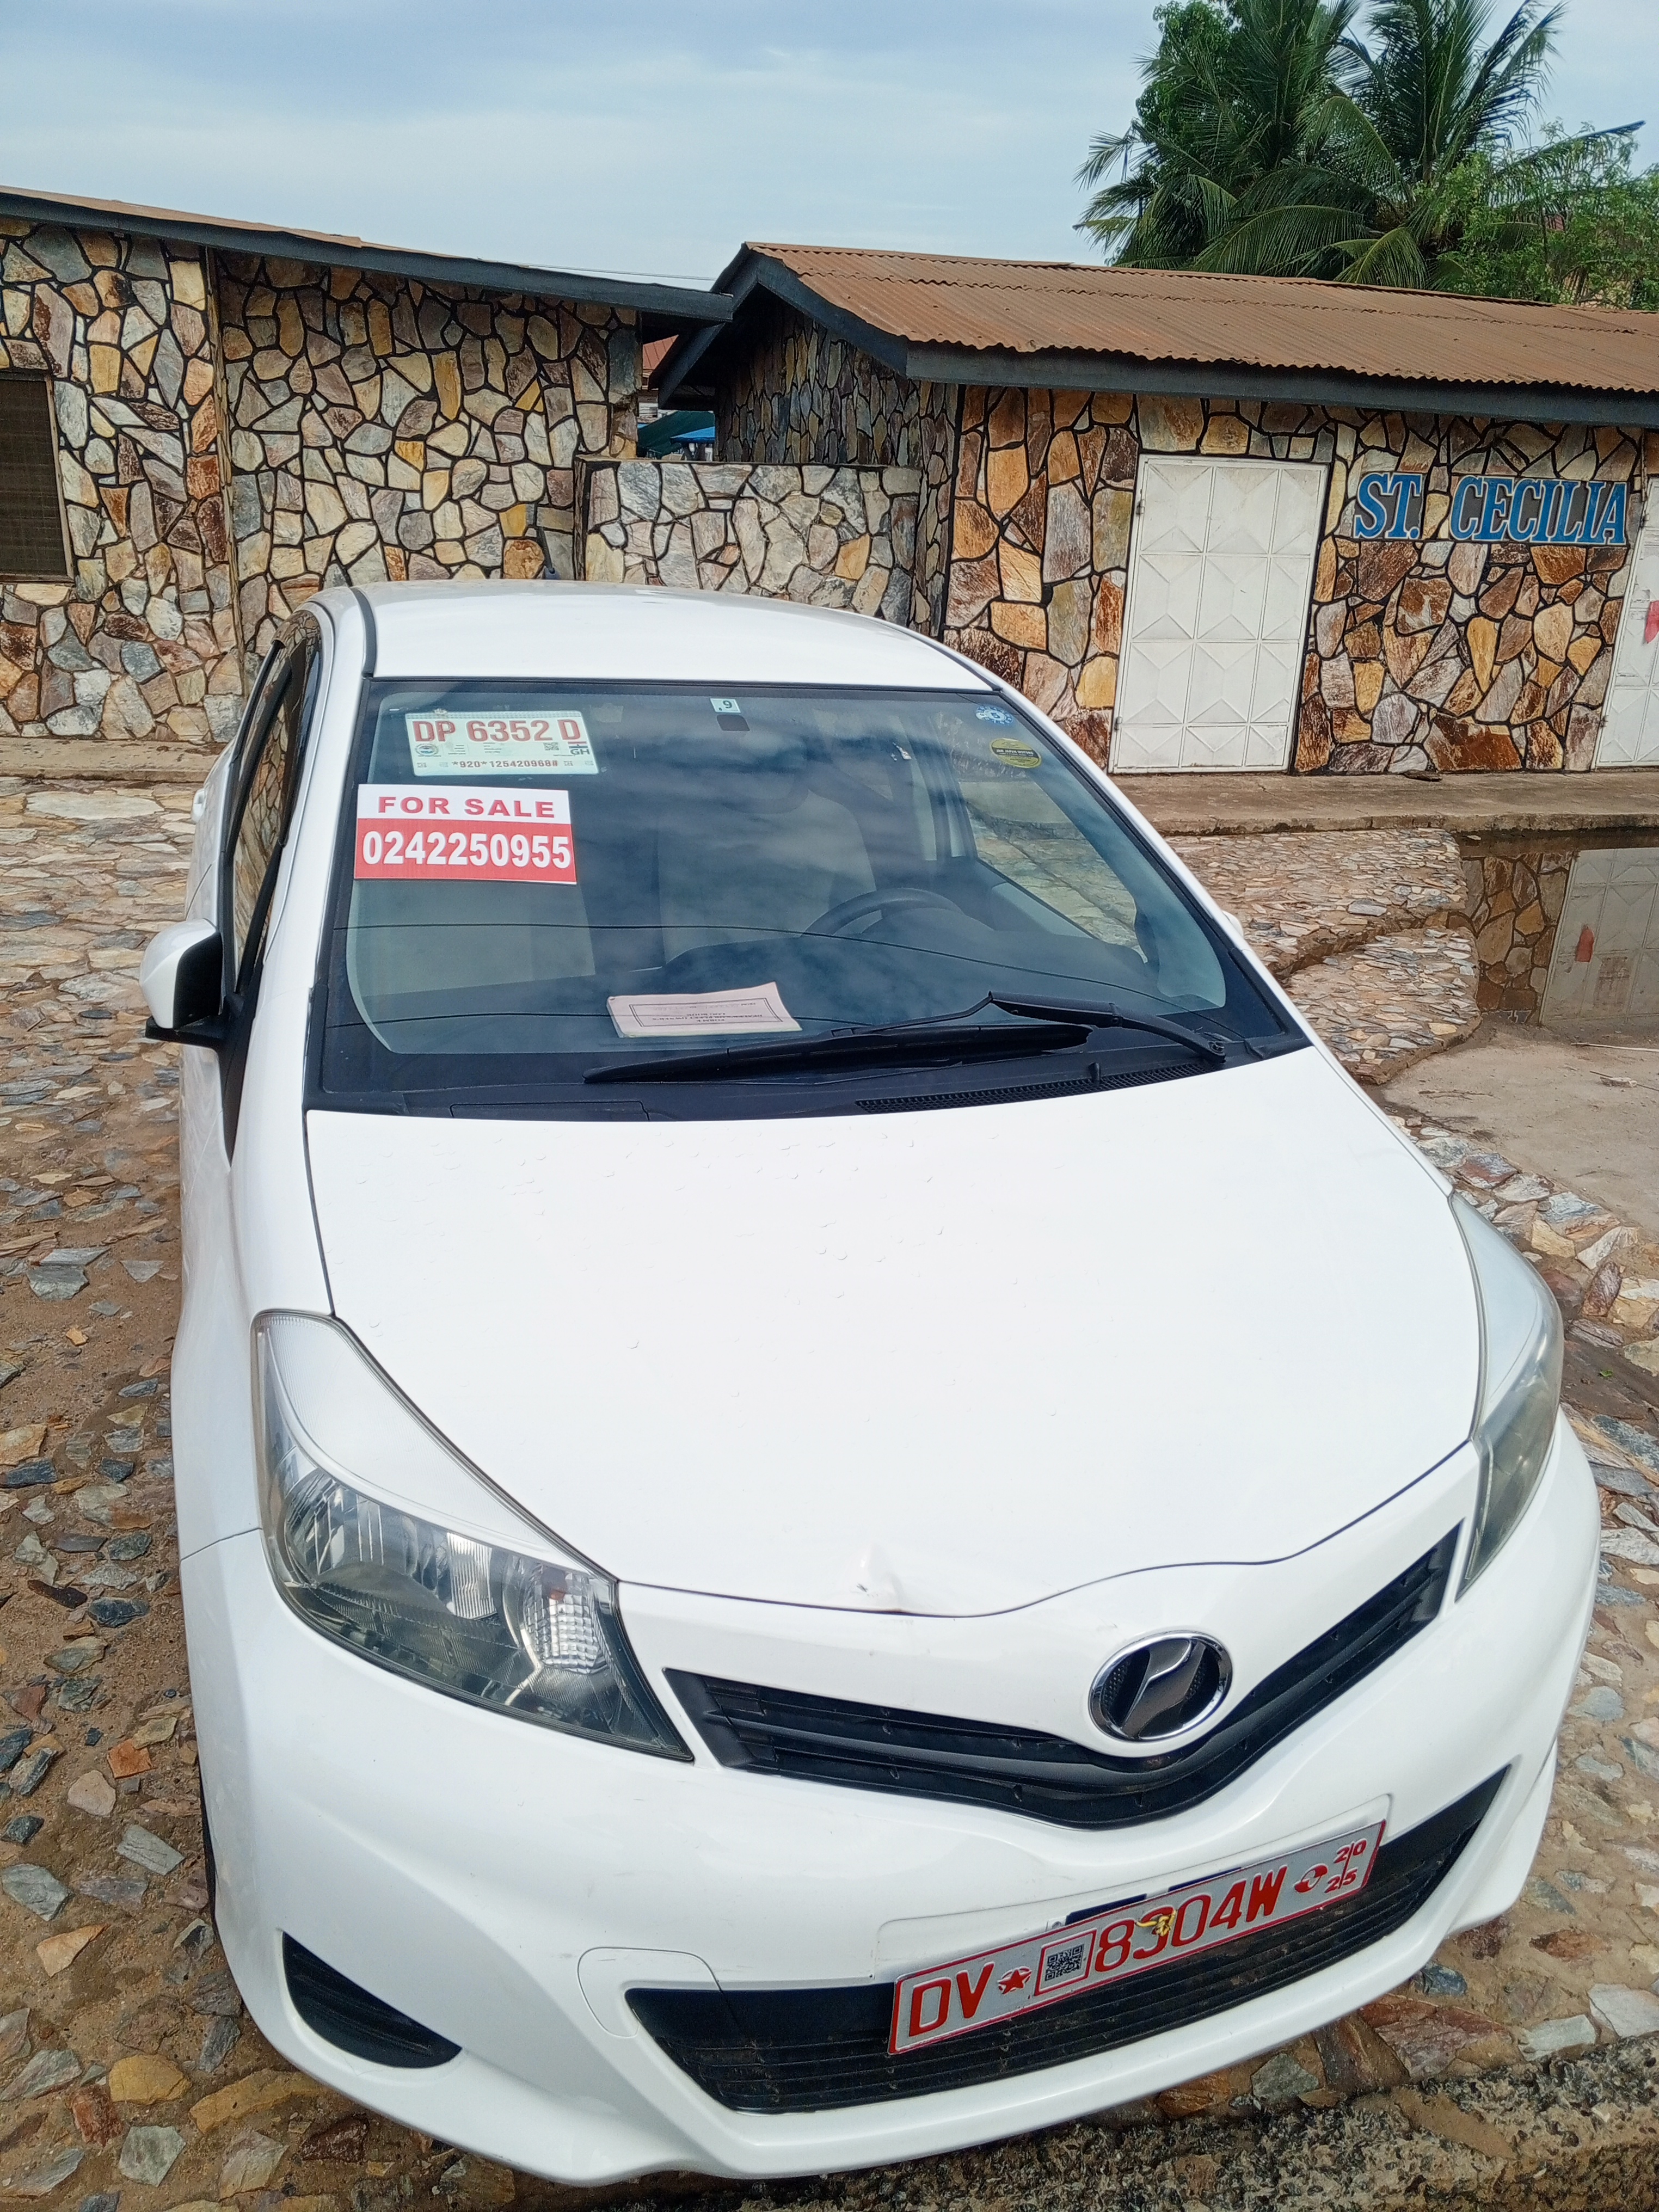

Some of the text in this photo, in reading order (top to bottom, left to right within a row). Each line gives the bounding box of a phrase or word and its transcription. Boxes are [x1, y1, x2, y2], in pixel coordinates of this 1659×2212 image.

[1354, 471, 1627, 545] ST. CECILIA
[411, 718, 581, 742] DP 6352 D
[378, 796, 555, 819] FOR SALE
[362, 831, 571, 869] 0242250955
[908, 1864, 1288, 2038] DV 8304W
